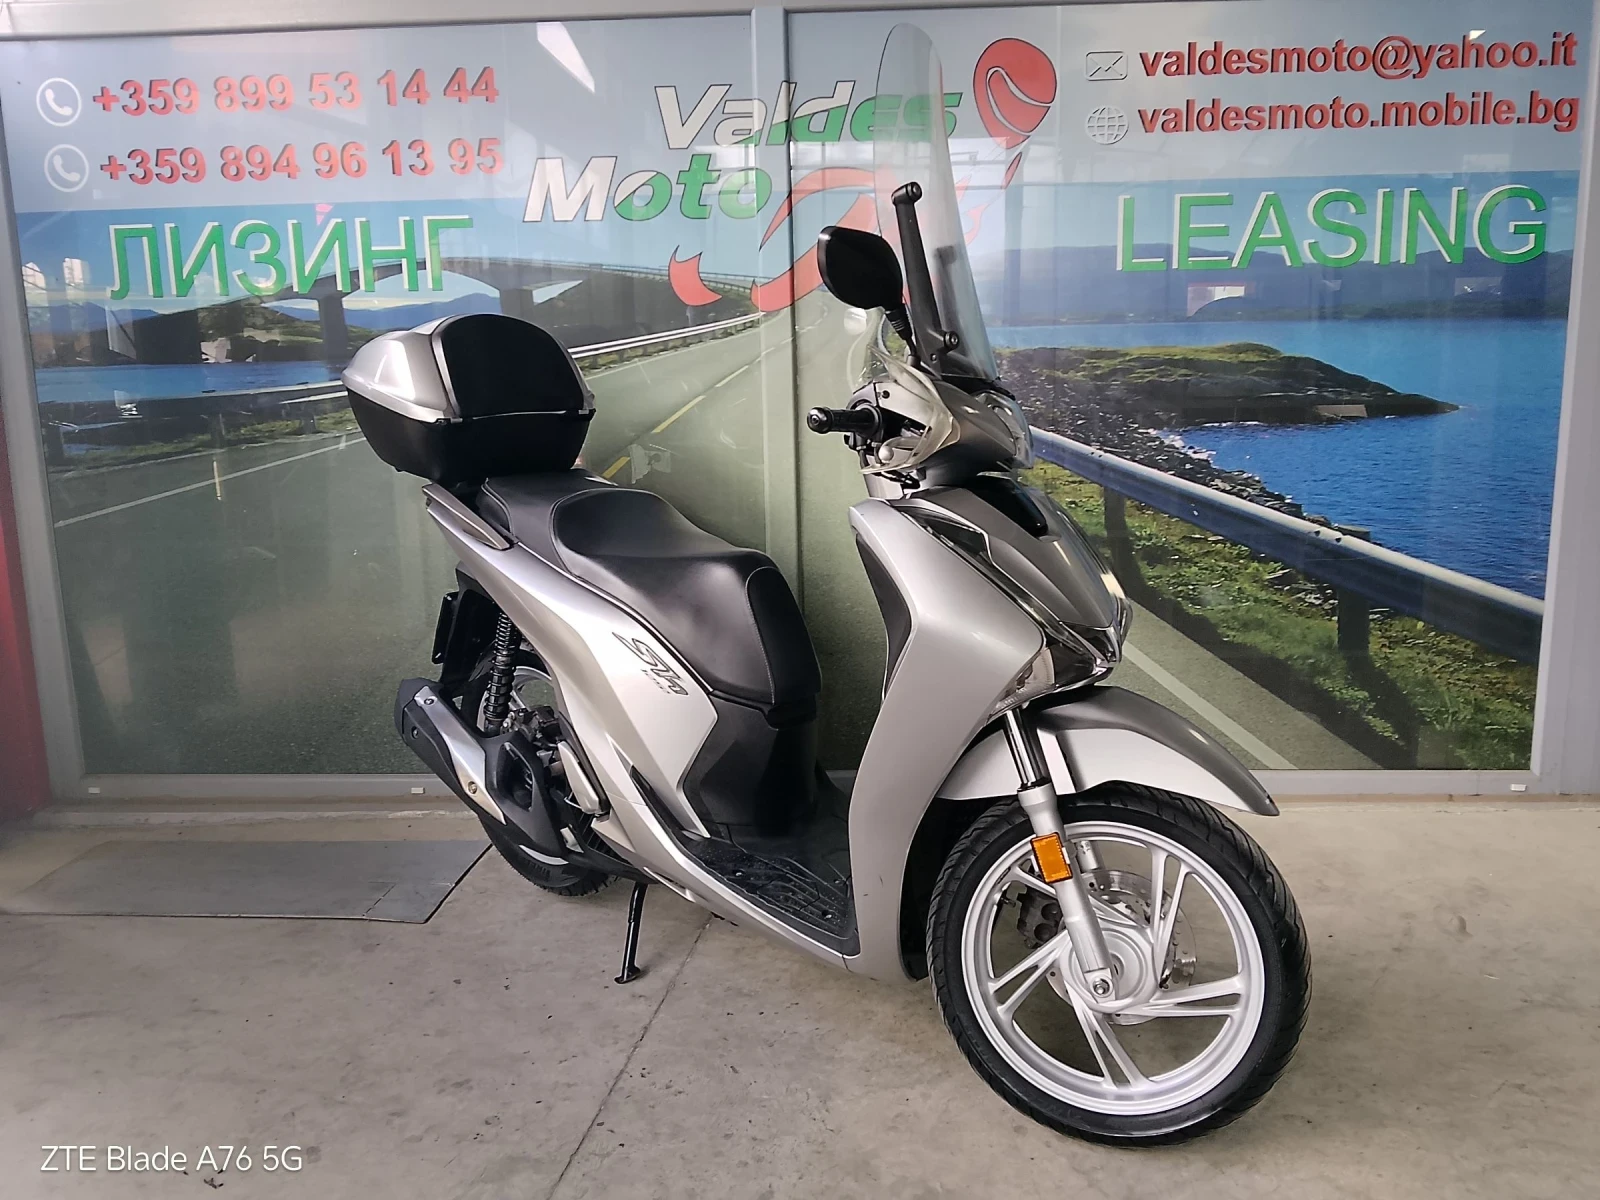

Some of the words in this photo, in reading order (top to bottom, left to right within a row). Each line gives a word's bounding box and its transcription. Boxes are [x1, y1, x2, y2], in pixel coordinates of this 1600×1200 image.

[1139, 31, 1578, 80] valdesmoto@yahoo.it
[93, 77, 200, 116] +359
[213, 73, 294, 113] 899
[308, 70, 363, 111] 53
[376, 67, 431, 106] 14
[443, 65, 500, 104] 44
[654, 79, 963, 150] Valdes
[1137, 90, 1580, 135] valdesmoto.mobile.bg
[100, 146, 207, 186] +359
[220, 143, 301, 183] 894
[313, 141, 368, 180] 96
[382, 138, 435, 177] 13
[448, 137, 504, 175] 95
[522, 152, 772, 223] Moto
[106, 214, 474, 300] ЛИЗИНГ
[1116, 184, 1548, 273] LEASING
